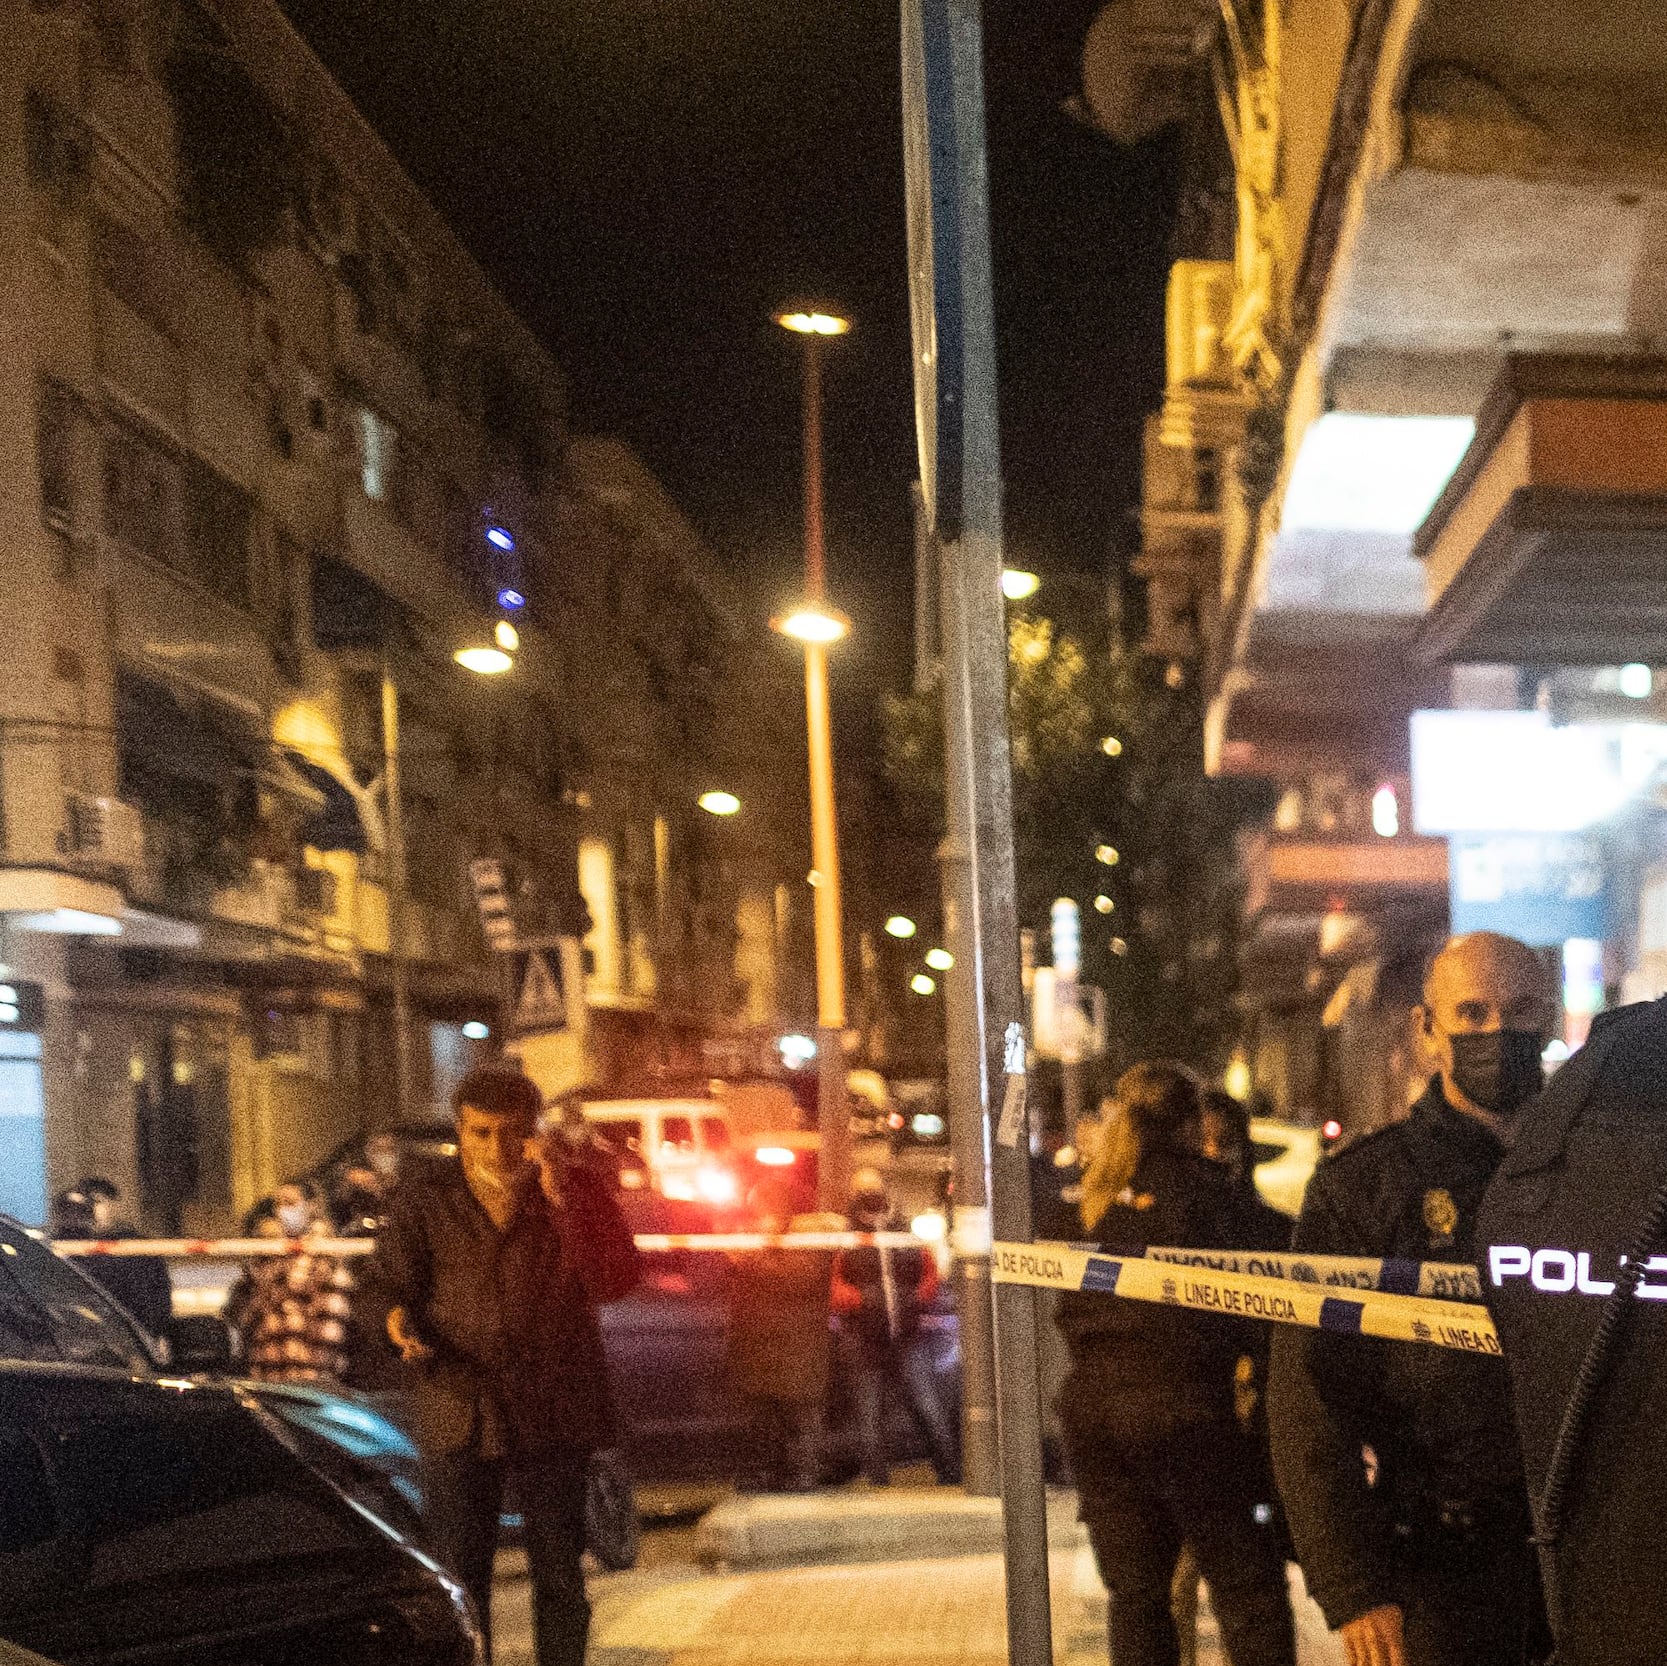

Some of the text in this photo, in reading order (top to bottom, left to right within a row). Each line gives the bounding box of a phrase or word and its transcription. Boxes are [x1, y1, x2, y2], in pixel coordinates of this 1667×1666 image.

[1002, 1252, 1018, 1273] DE
[1020, 1255, 1063, 1280] POLICIA
[1184, 1282, 1298, 1321] LINEA DE POLICIA
[1437, 1324, 1489, 1353] LINEA
